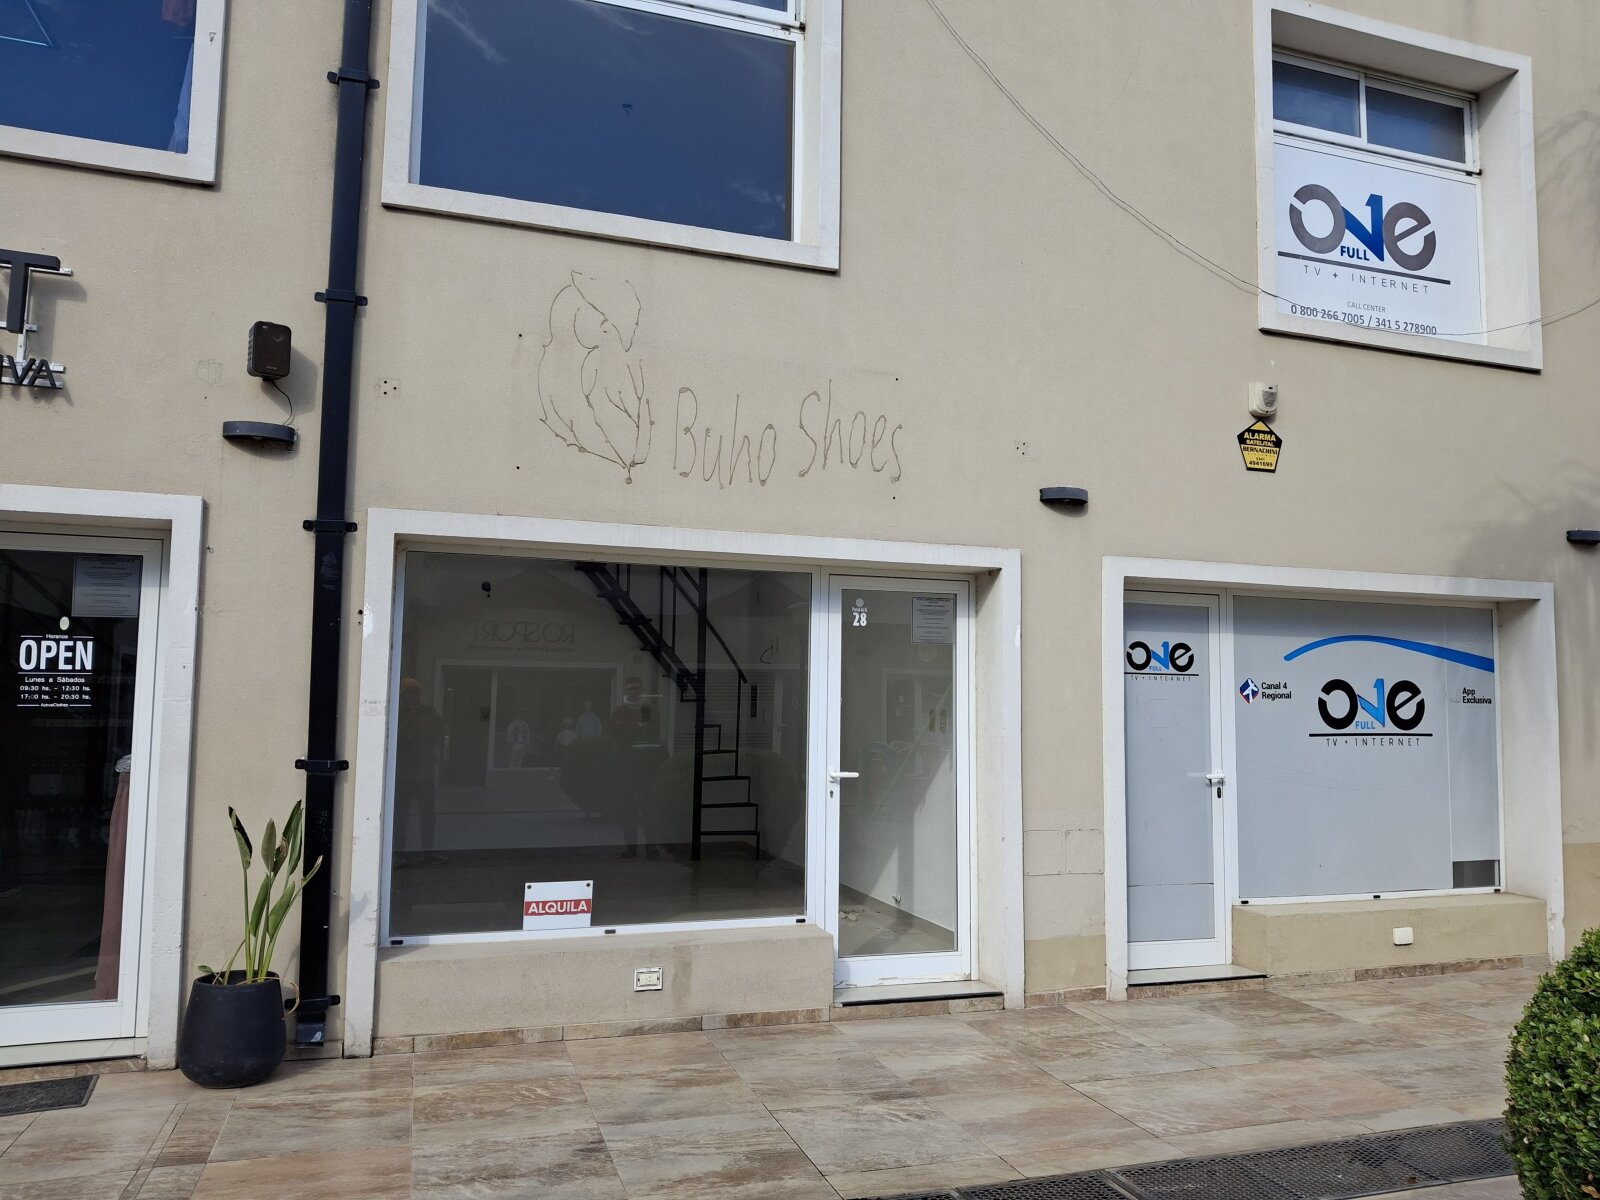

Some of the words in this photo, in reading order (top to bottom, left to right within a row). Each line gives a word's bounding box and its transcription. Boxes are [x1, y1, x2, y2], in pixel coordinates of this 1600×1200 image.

[1340, 245, 1370, 261] FULL
[1303, 265, 1321, 276] TV
[1351, 273, 1429, 294] INTERNET
[1347, 301, 1362, 310] CALL
[1363, 304, 1386, 313] CENTER
[1290, 304, 1298, 315] 0
[1300, 305, 1318, 317] 800
[1321, 309, 1339, 321] 266
[1341, 312, 1365, 325] 7005
[1367, 315, 1373, 327] /
[1375, 317, 1392, 329] 341
[1395, 320, 1401, 330] 5
[1403, 321, 1437, 336] 278900
[673, 386, 777, 490] Buho
[798, 378, 903, 484] Shoes
[1243, 431, 1276, 442] ALARMA
[1246, 439, 1275, 447] SATELITAL
[1242, 446, 1278, 455] BERNACHINI
[852, 612, 867, 627] 28
[19, 639, 93, 671] OPEN
[1261, 681, 1281, 690] Canal
[1282, 682, 1288, 690] 4
[1261, 690, 1292, 702] Regional
[1462, 687, 1476, 697] App
[1462, 695, 1492, 705] Exclusiva
[1355, 720, 1376, 730] FULL
[1326, 738, 1338, 747] TV
[1355, 738, 1421, 747] INTERNET
[528, 900, 588, 914] ALQUILA
